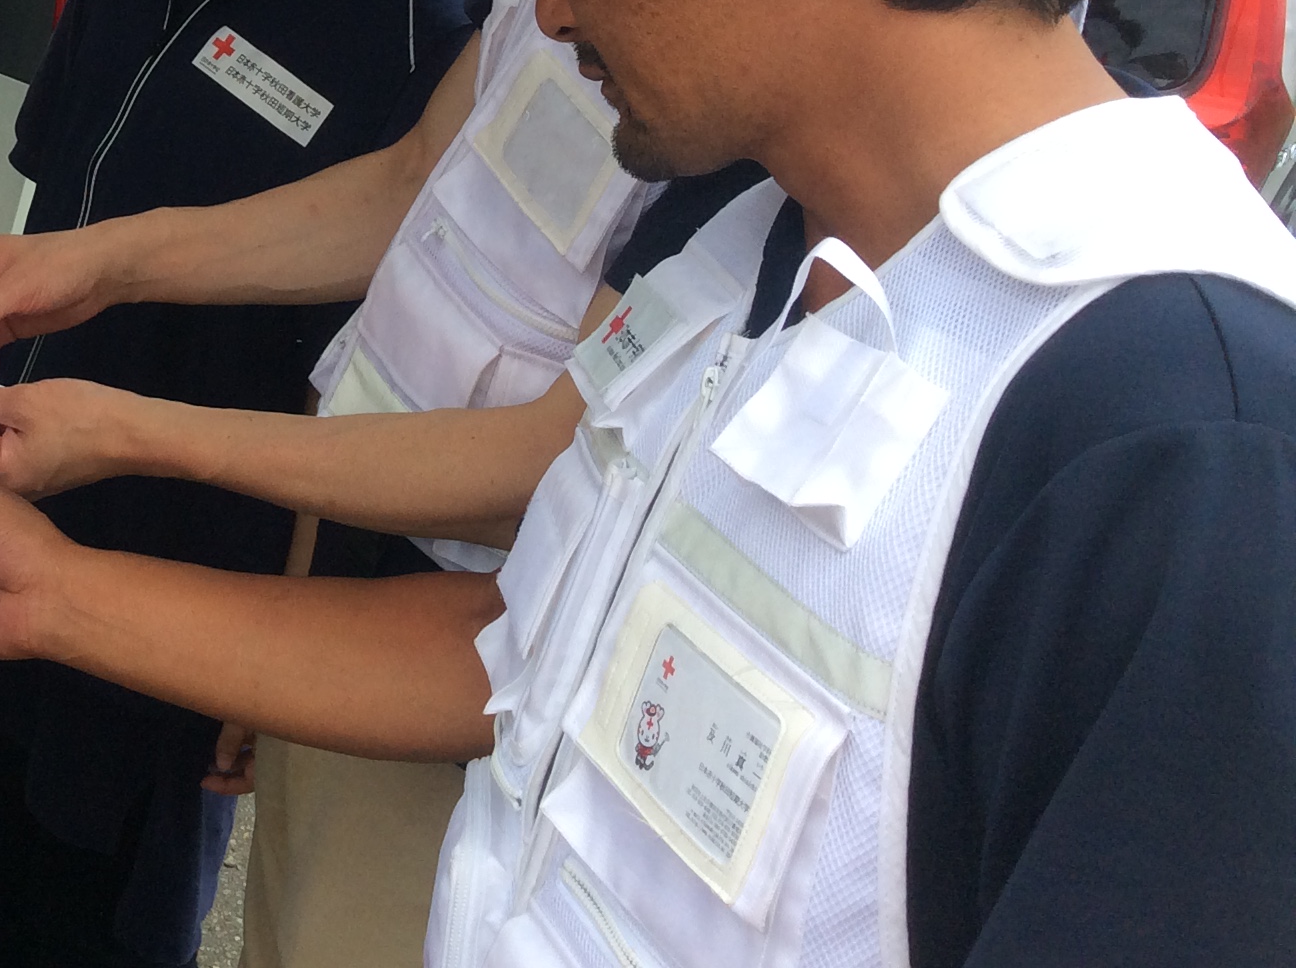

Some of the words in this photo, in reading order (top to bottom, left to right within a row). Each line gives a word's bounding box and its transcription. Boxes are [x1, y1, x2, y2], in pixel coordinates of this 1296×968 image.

[225, 65, 312, 132] 日本赤十字秋田短期大学
[236, 53, 322, 119] 日本赤十字秋田看護大学
